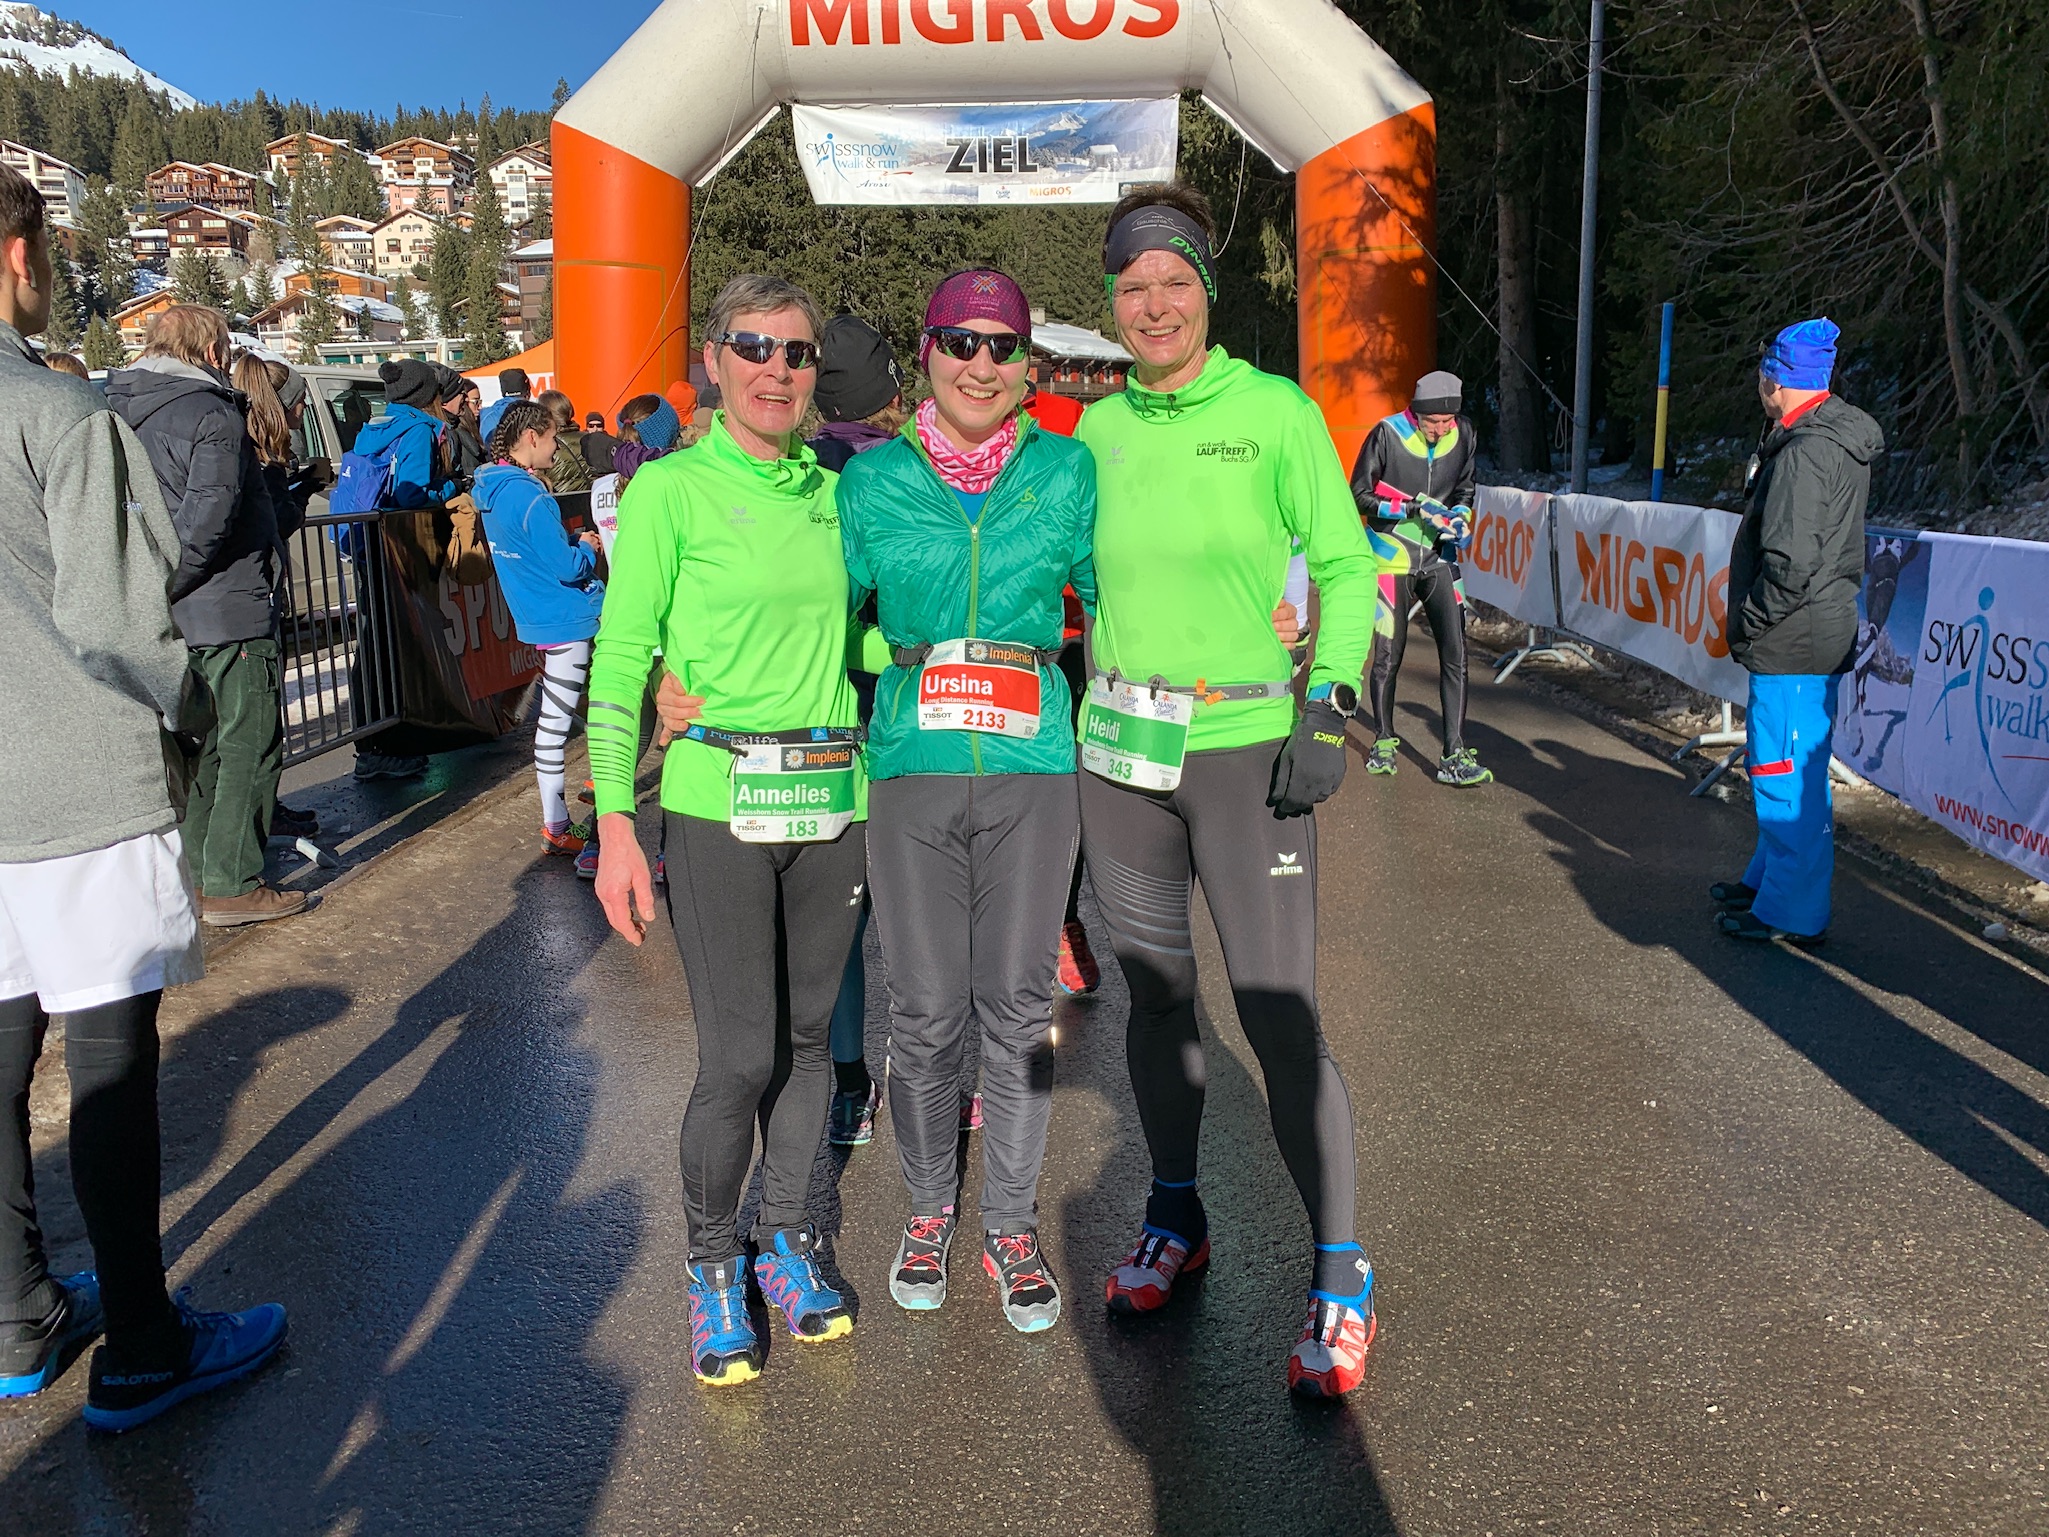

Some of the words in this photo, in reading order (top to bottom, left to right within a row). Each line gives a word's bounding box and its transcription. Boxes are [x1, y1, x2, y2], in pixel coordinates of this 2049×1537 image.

[945, 136, 1039, 173] ZIEL
[837, 160, 864, 169] walk
[865, 159, 876, 169] &
[878, 160, 899, 169] run
[1029, 186, 1072, 197] MIGROS
[1168, 235, 1215, 297] DYNAFIT
[1220, 455, 1238, 463] Buchs
[1576, 530, 1731, 659] MIGROS
[989, 647, 1032, 664] Implenia
[925, 673, 993, 696] Ursina
[925, 697, 940, 705] Long
[941, 696, 968, 704] Distance
[969, 697, 994, 707] Running
[963, 709, 1006, 729] 2133
[1088, 714, 1121, 742] Heidi
[1313, 731, 1339, 745] asics
[806, 748, 850, 767] Implenia
[1084, 753, 1101, 763] TISSOT
[1123, 749, 1148, 761] Running
[1107, 758, 1133, 780] 343
[736, 783, 831, 805] Annelies
[737, 808, 772, 816] Weisshorn
[772, 808, 789, 816] Snow
[790, 807, 804, 816] Trail
[805, 806, 830, 815] Running
[785, 820, 818, 837] 183
[1270, 865, 1303, 876] erima
